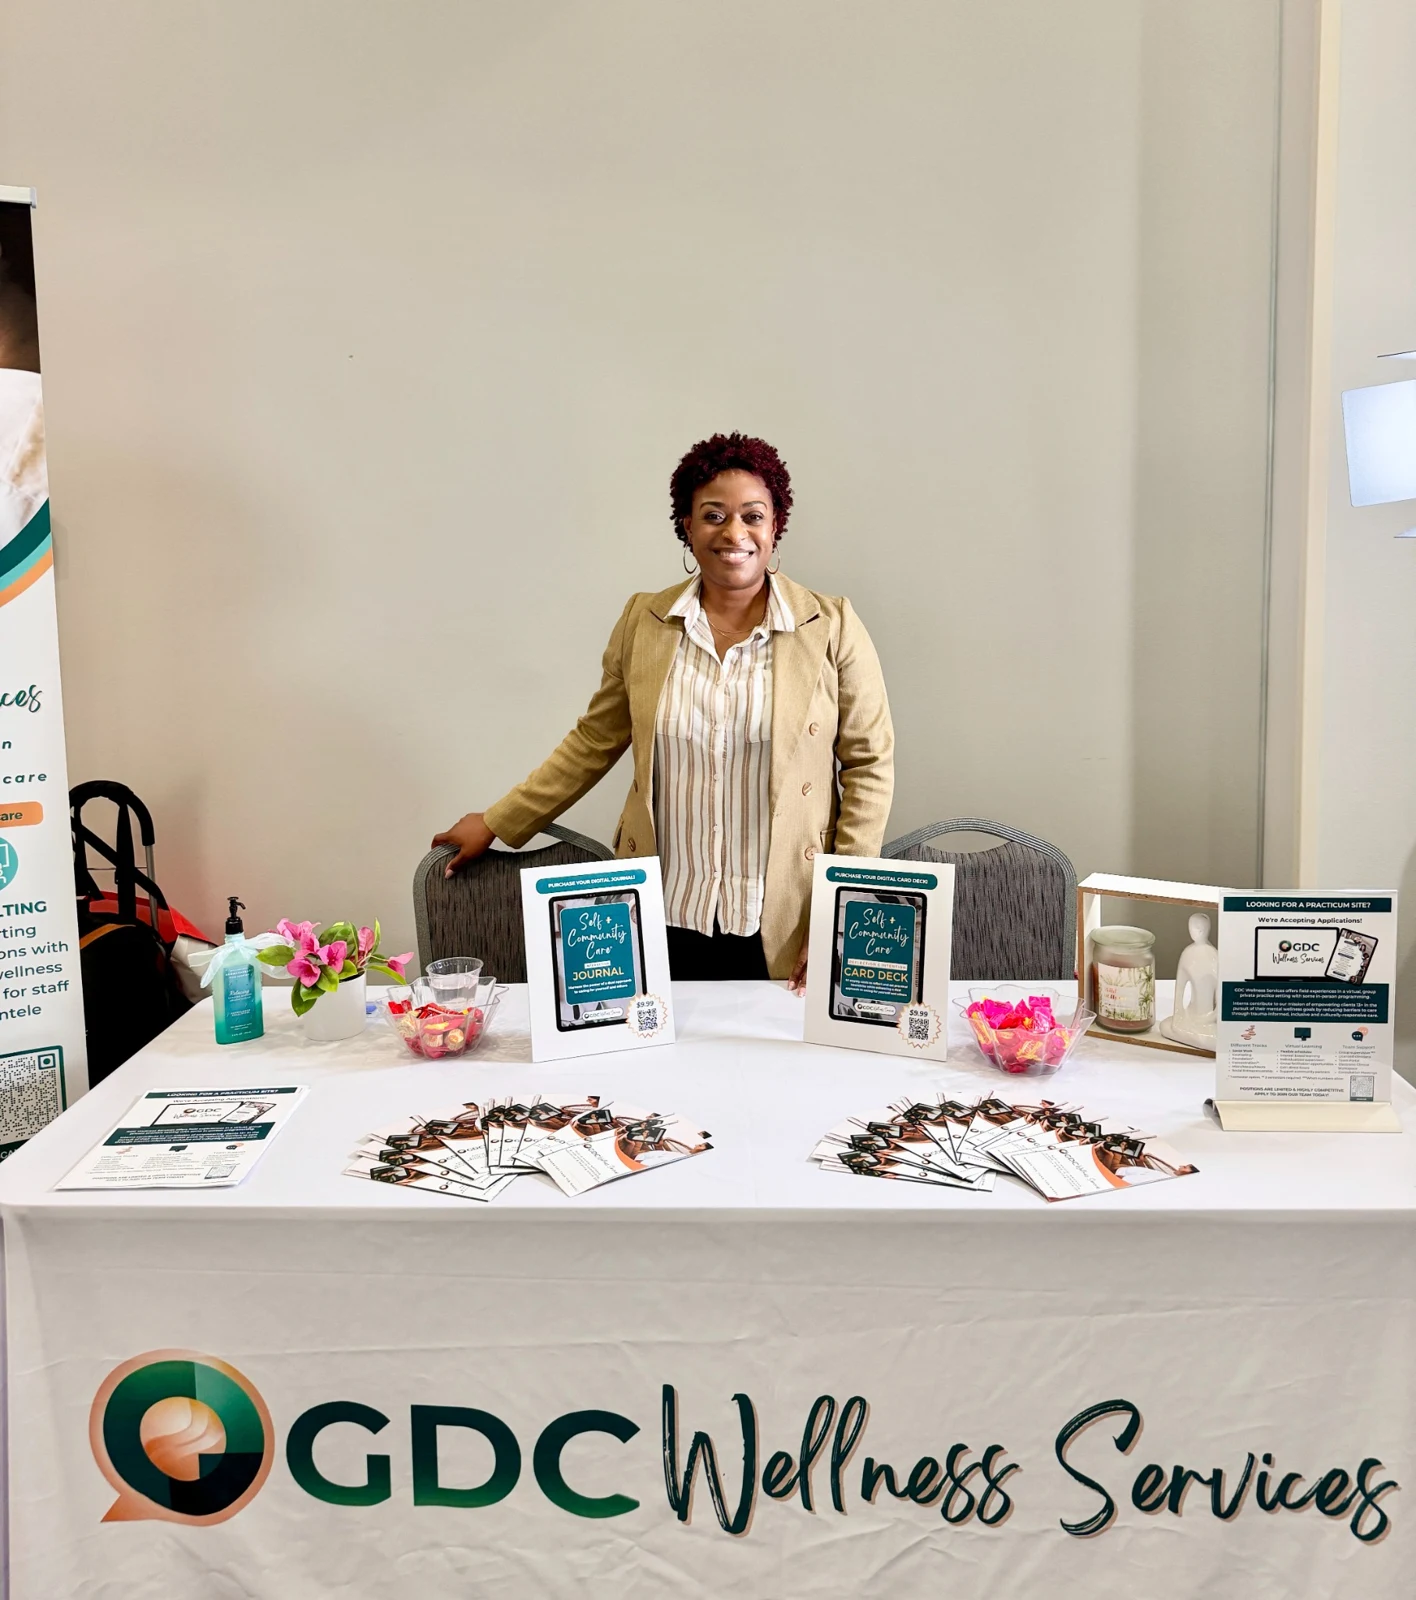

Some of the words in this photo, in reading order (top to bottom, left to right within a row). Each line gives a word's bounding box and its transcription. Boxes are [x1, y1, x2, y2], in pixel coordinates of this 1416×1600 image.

[3, 773, 47, 784] care
[0, 811, 23, 821] are
[548, 880, 576, 888] PURCHASE
[576, 878, 591, 886] YOUR
[0, 901, 47, 917] TING
[578, 912, 603, 931] Self
[862, 908, 886, 928] Self
[1280, 917, 1316, 925] Accepting
[1317, 917, 1362, 925] Applications!
[0, 926, 36, 938] ting
[567, 924, 627, 948] Community
[848, 922, 909, 947] Community
[31, 941, 69, 955] with
[586, 941, 613, 960] Care
[865, 938, 893, 956] Care
[1292, 942, 1320, 952] GDC
[1272, 952, 1298, 964] Wellness
[0, 963, 63, 980] ellness
[573, 966, 624, 981] JOURNAL
[844, 967, 875, 979] CARD
[878, 970, 908, 983] DECK
[3, 986, 27, 999] for
[32, 980, 69, 995] staff
[636, 1000, 654, 1009] $9.99
[909, 1009, 928, 1017] $9.99
[286, 1399, 641, 1519] GDC
[662, 1384, 1021, 1537] Wellness
[1055, 1399, 1401, 1544] Services
